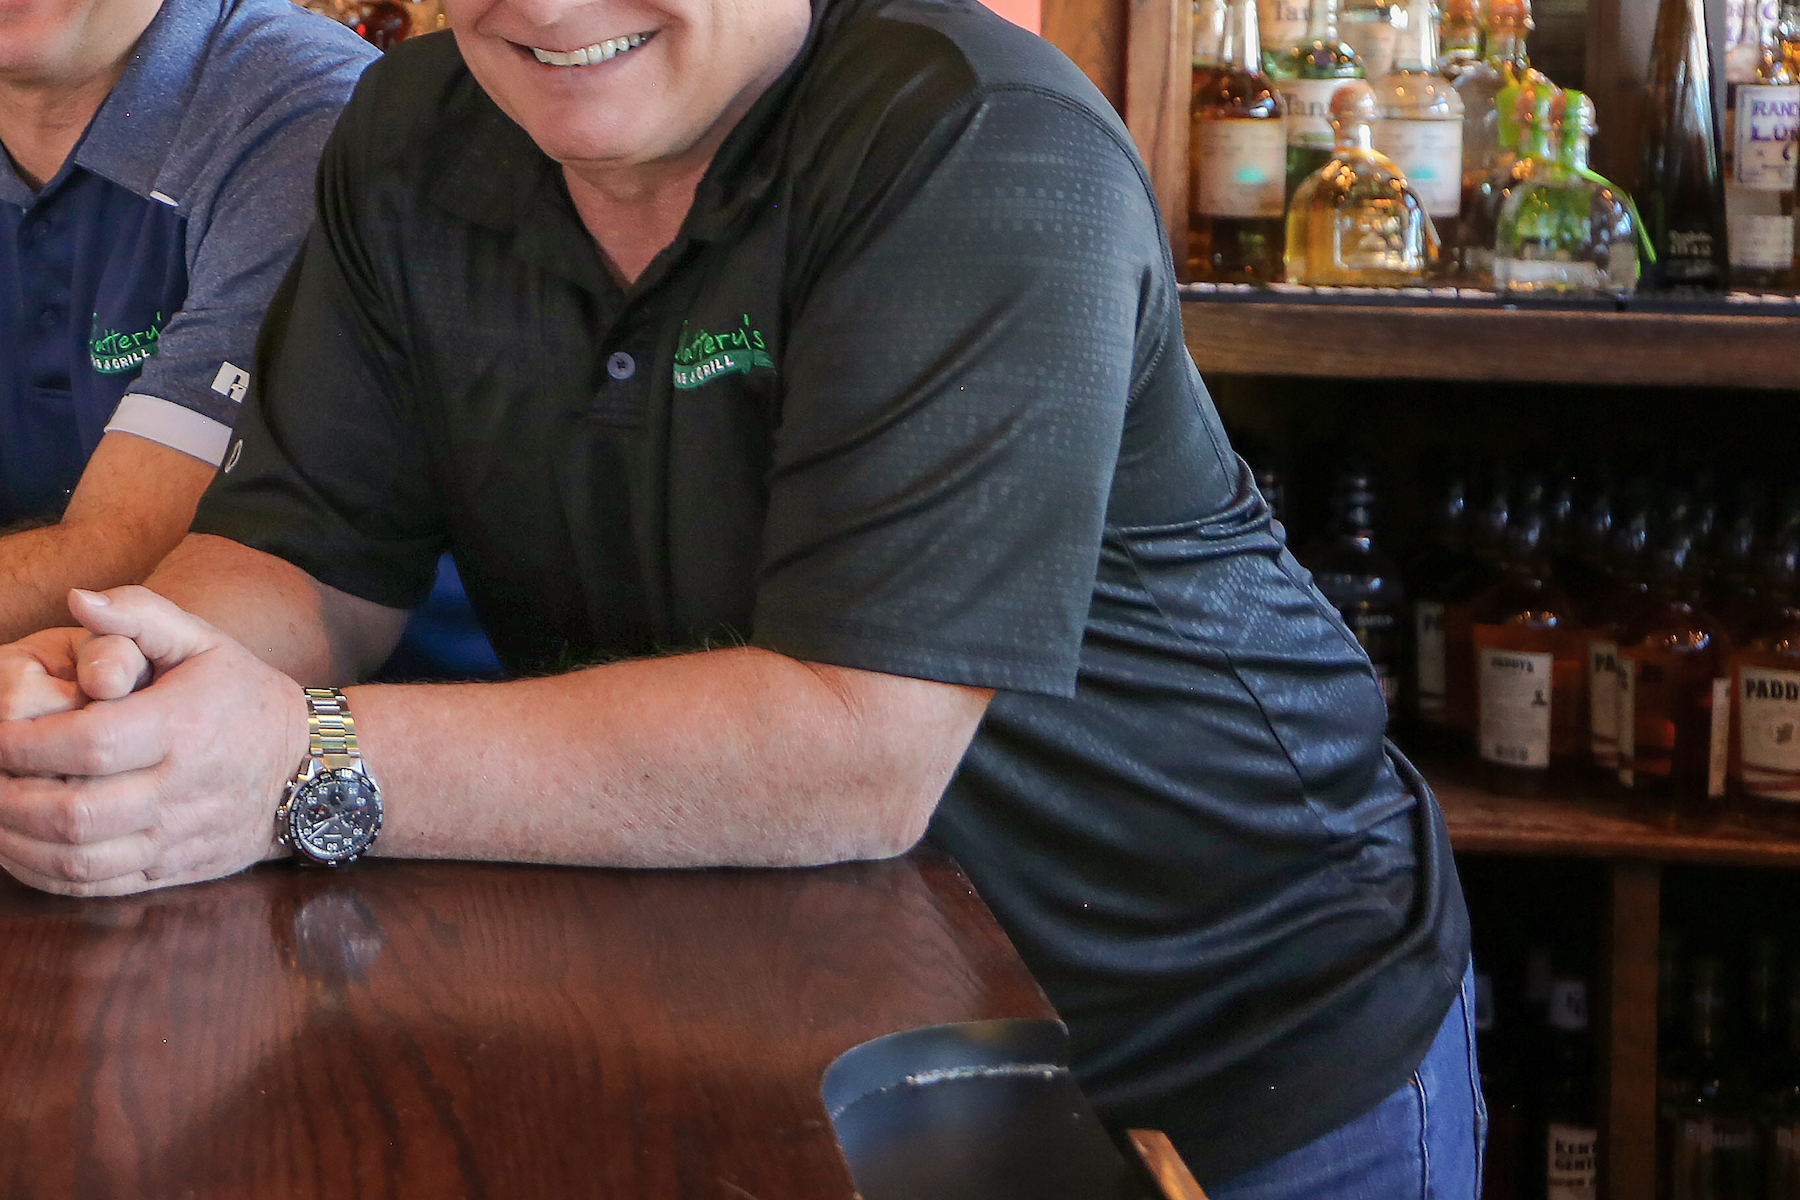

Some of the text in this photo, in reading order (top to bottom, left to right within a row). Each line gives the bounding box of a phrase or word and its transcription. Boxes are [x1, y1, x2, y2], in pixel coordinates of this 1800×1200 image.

[1275, 0, 1309, 22] Tan
[111, 348, 151, 370] GRILL
[696, 354, 735, 381] GRILL
